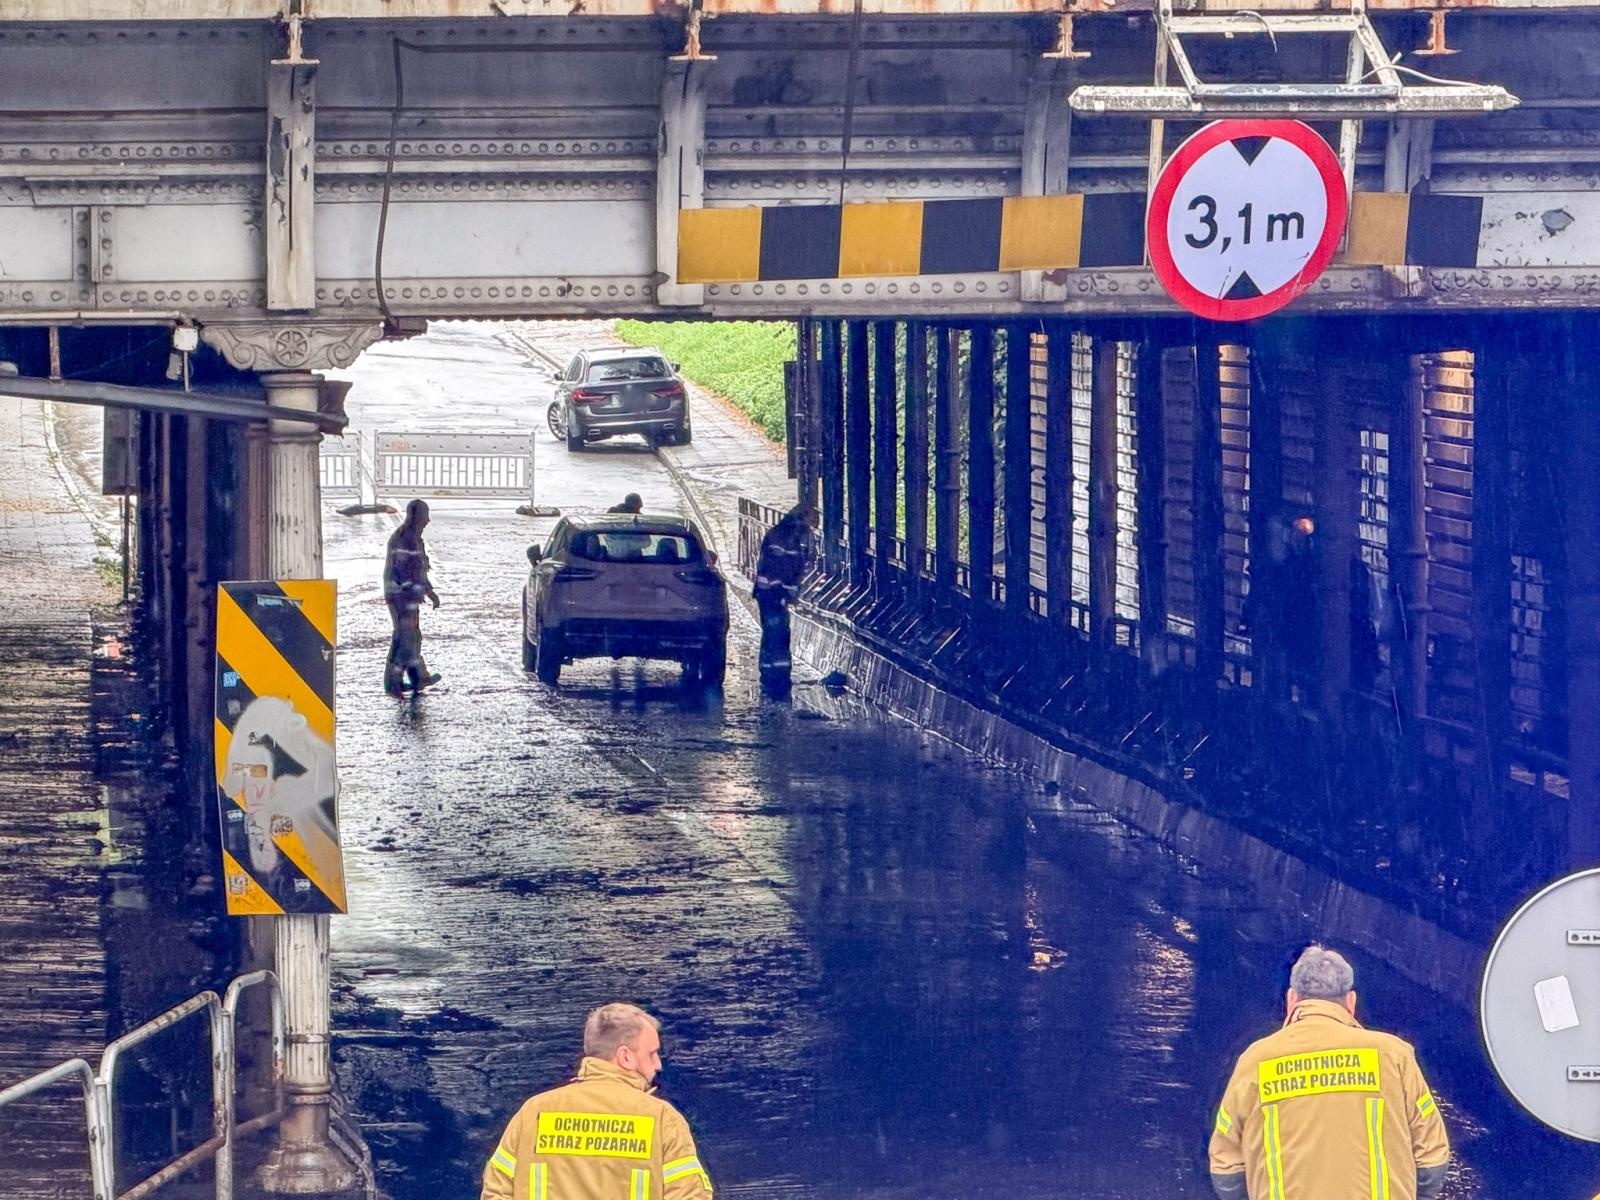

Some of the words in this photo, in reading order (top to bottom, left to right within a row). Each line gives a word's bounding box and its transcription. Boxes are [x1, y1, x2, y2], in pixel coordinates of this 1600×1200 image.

[1184, 194, 1253, 255] 3,1
[1265, 211, 1305, 243] m
[1276, 1054, 1361, 1076] OCHOTNICZA
[554, 1117, 635, 1134] OCHOTNICZA
